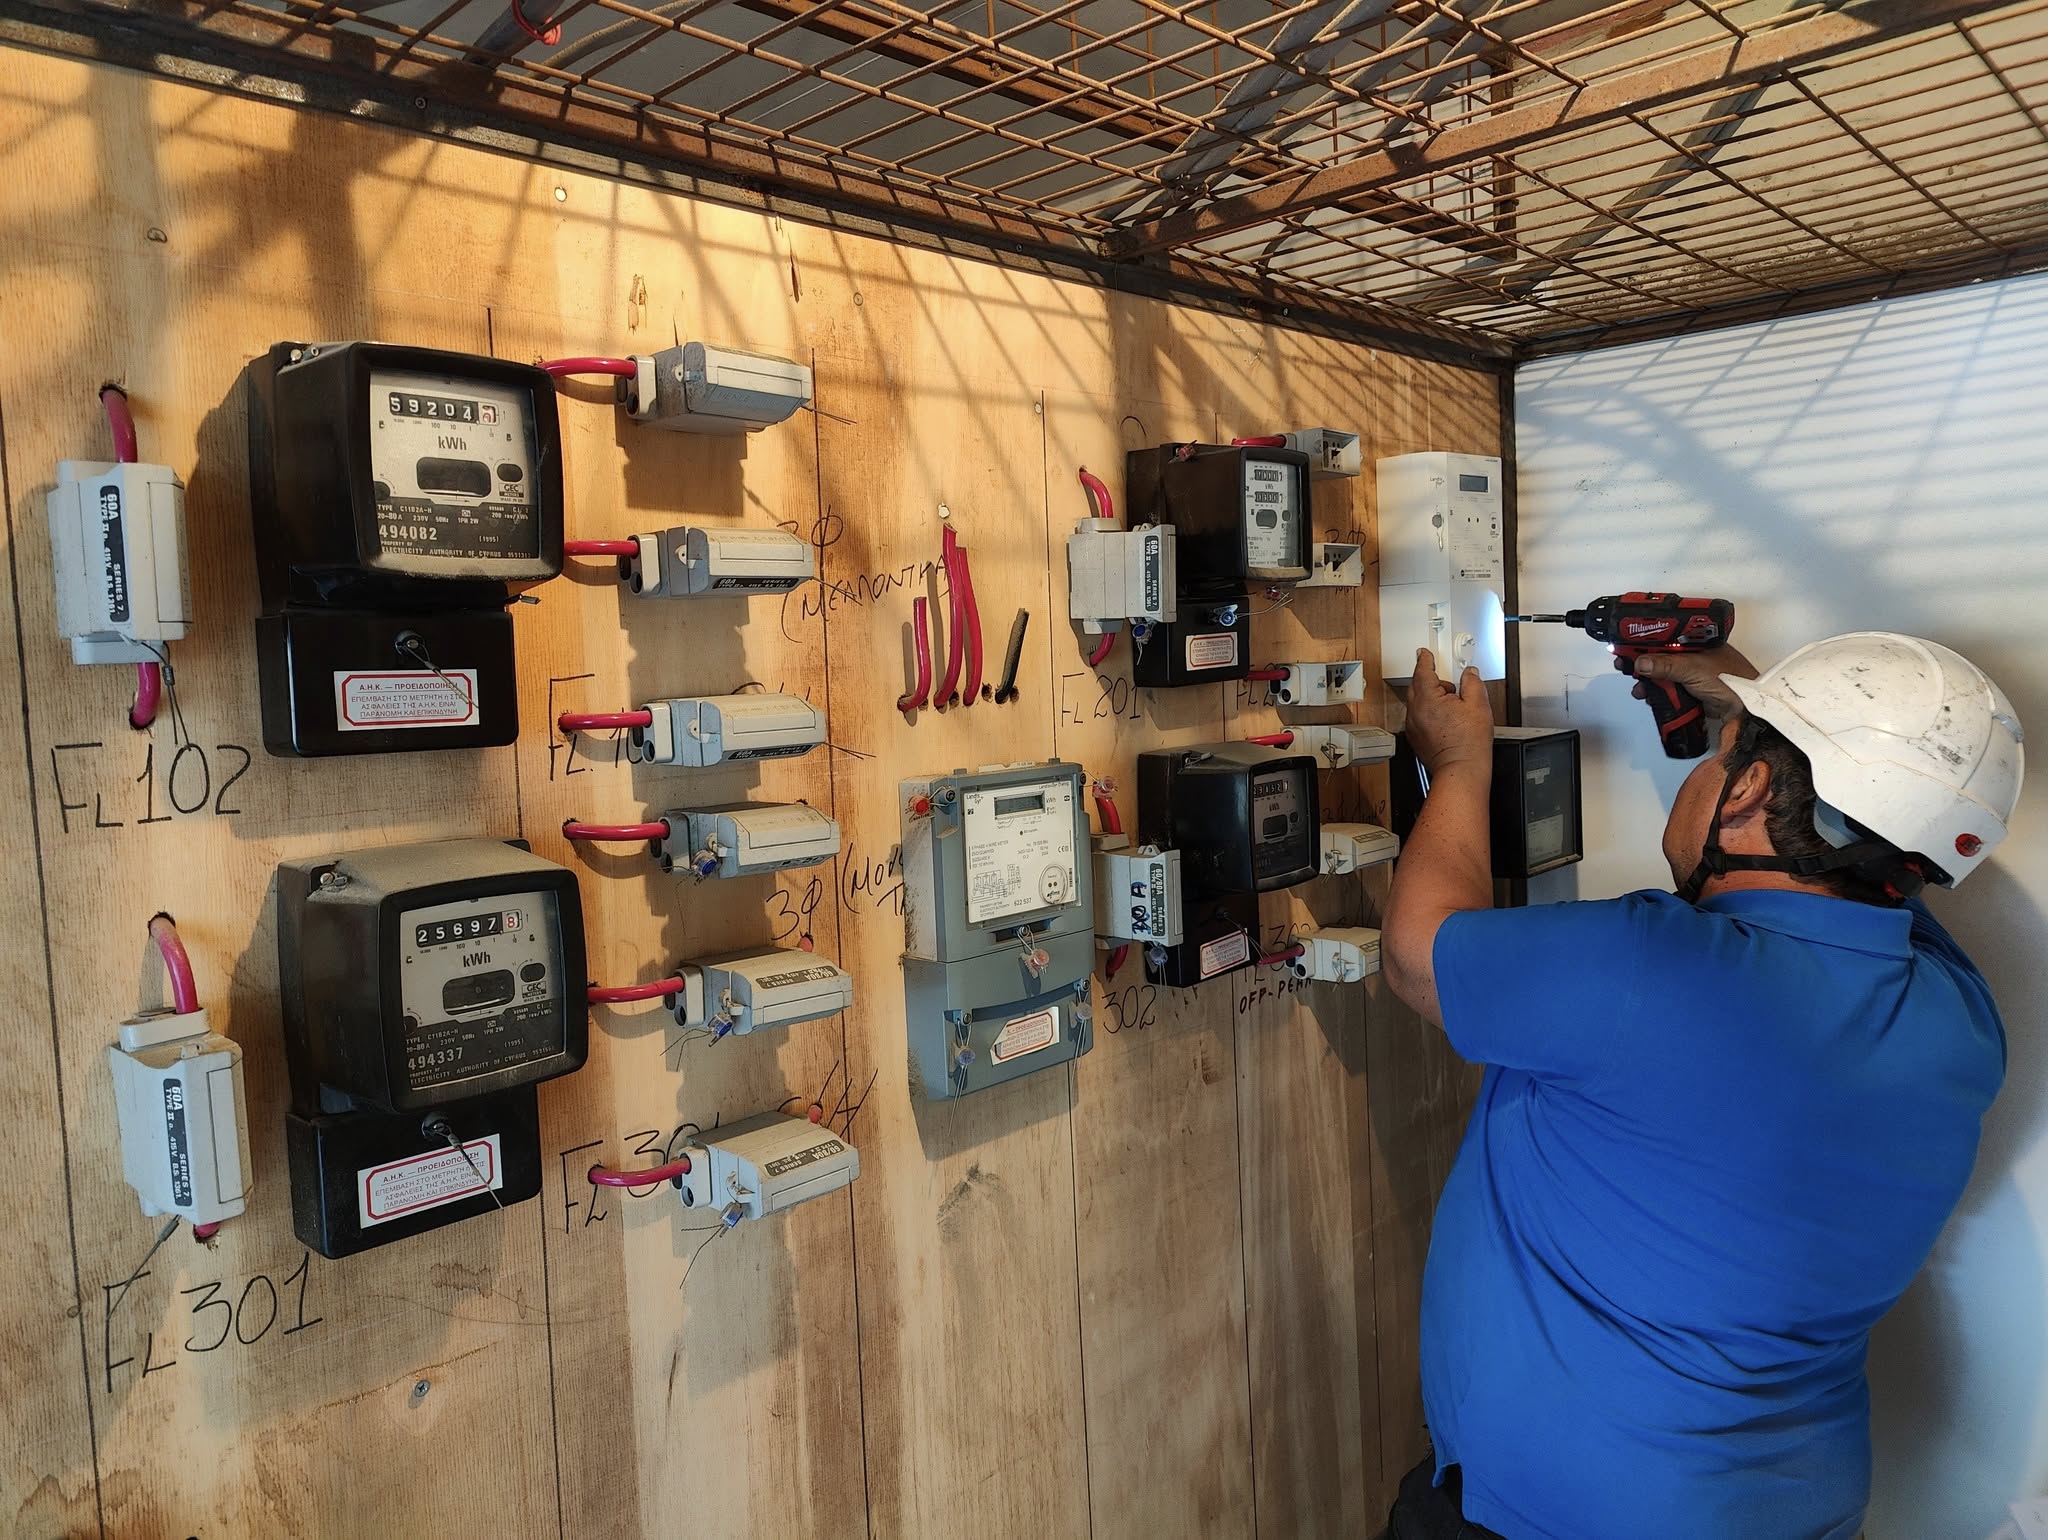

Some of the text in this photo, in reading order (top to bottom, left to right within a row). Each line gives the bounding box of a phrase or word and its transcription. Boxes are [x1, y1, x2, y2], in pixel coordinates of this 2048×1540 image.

[438, 436, 467, 451] kWh
[100, 496, 108, 521] TYPE
[378, 504, 393, 512] TYPE
[379, 524, 438, 541] 494082
[108, 494, 119, 520] 60A
[114, 563, 124, 601] SERIES
[382, 546, 423, 554] ELECTRICITY
[430, 548, 463, 556] AUTHORITY
[1150, 540, 1158, 554] 60A
[1628, 621, 1669, 634] Milwaukee
[463, 951, 491, 968] kWh
[527, 982, 542, 991] GEC
[1102, 984, 1157, 1034] 302
[406, 1037, 421, 1045] TYPE
[408, 1047, 463, 1070] 494337
[411, 1071, 450, 1085] ELECTRICITY
[457, 1062, 489, 1074] AUTHORITY
[165, 1088, 173, 1110] TYPE
[172, 1086, 183, 1111] 60A
[179, 1154, 189, 1188] SERIES
[375, 1181, 415, 1196] ΕΠΕΜΒΑΣΗ
[416, 1177, 431, 1185] ΣΤΟ
[431, 1168, 465, 1180] ΜΕΤΡΗΤΗ
[384, 1186, 424, 1201] ΑΣΦΑΛΕΙΕΣ
[426, 1182, 438, 1190] ΤΗΣ
[384, 1178, 479, 1208] ΠΑΡΑΝΟΜΗ ΚΑΙ ΕΠΙΚΙΝΔΥΝΗ
[180, 1252, 324, 1353] 301
